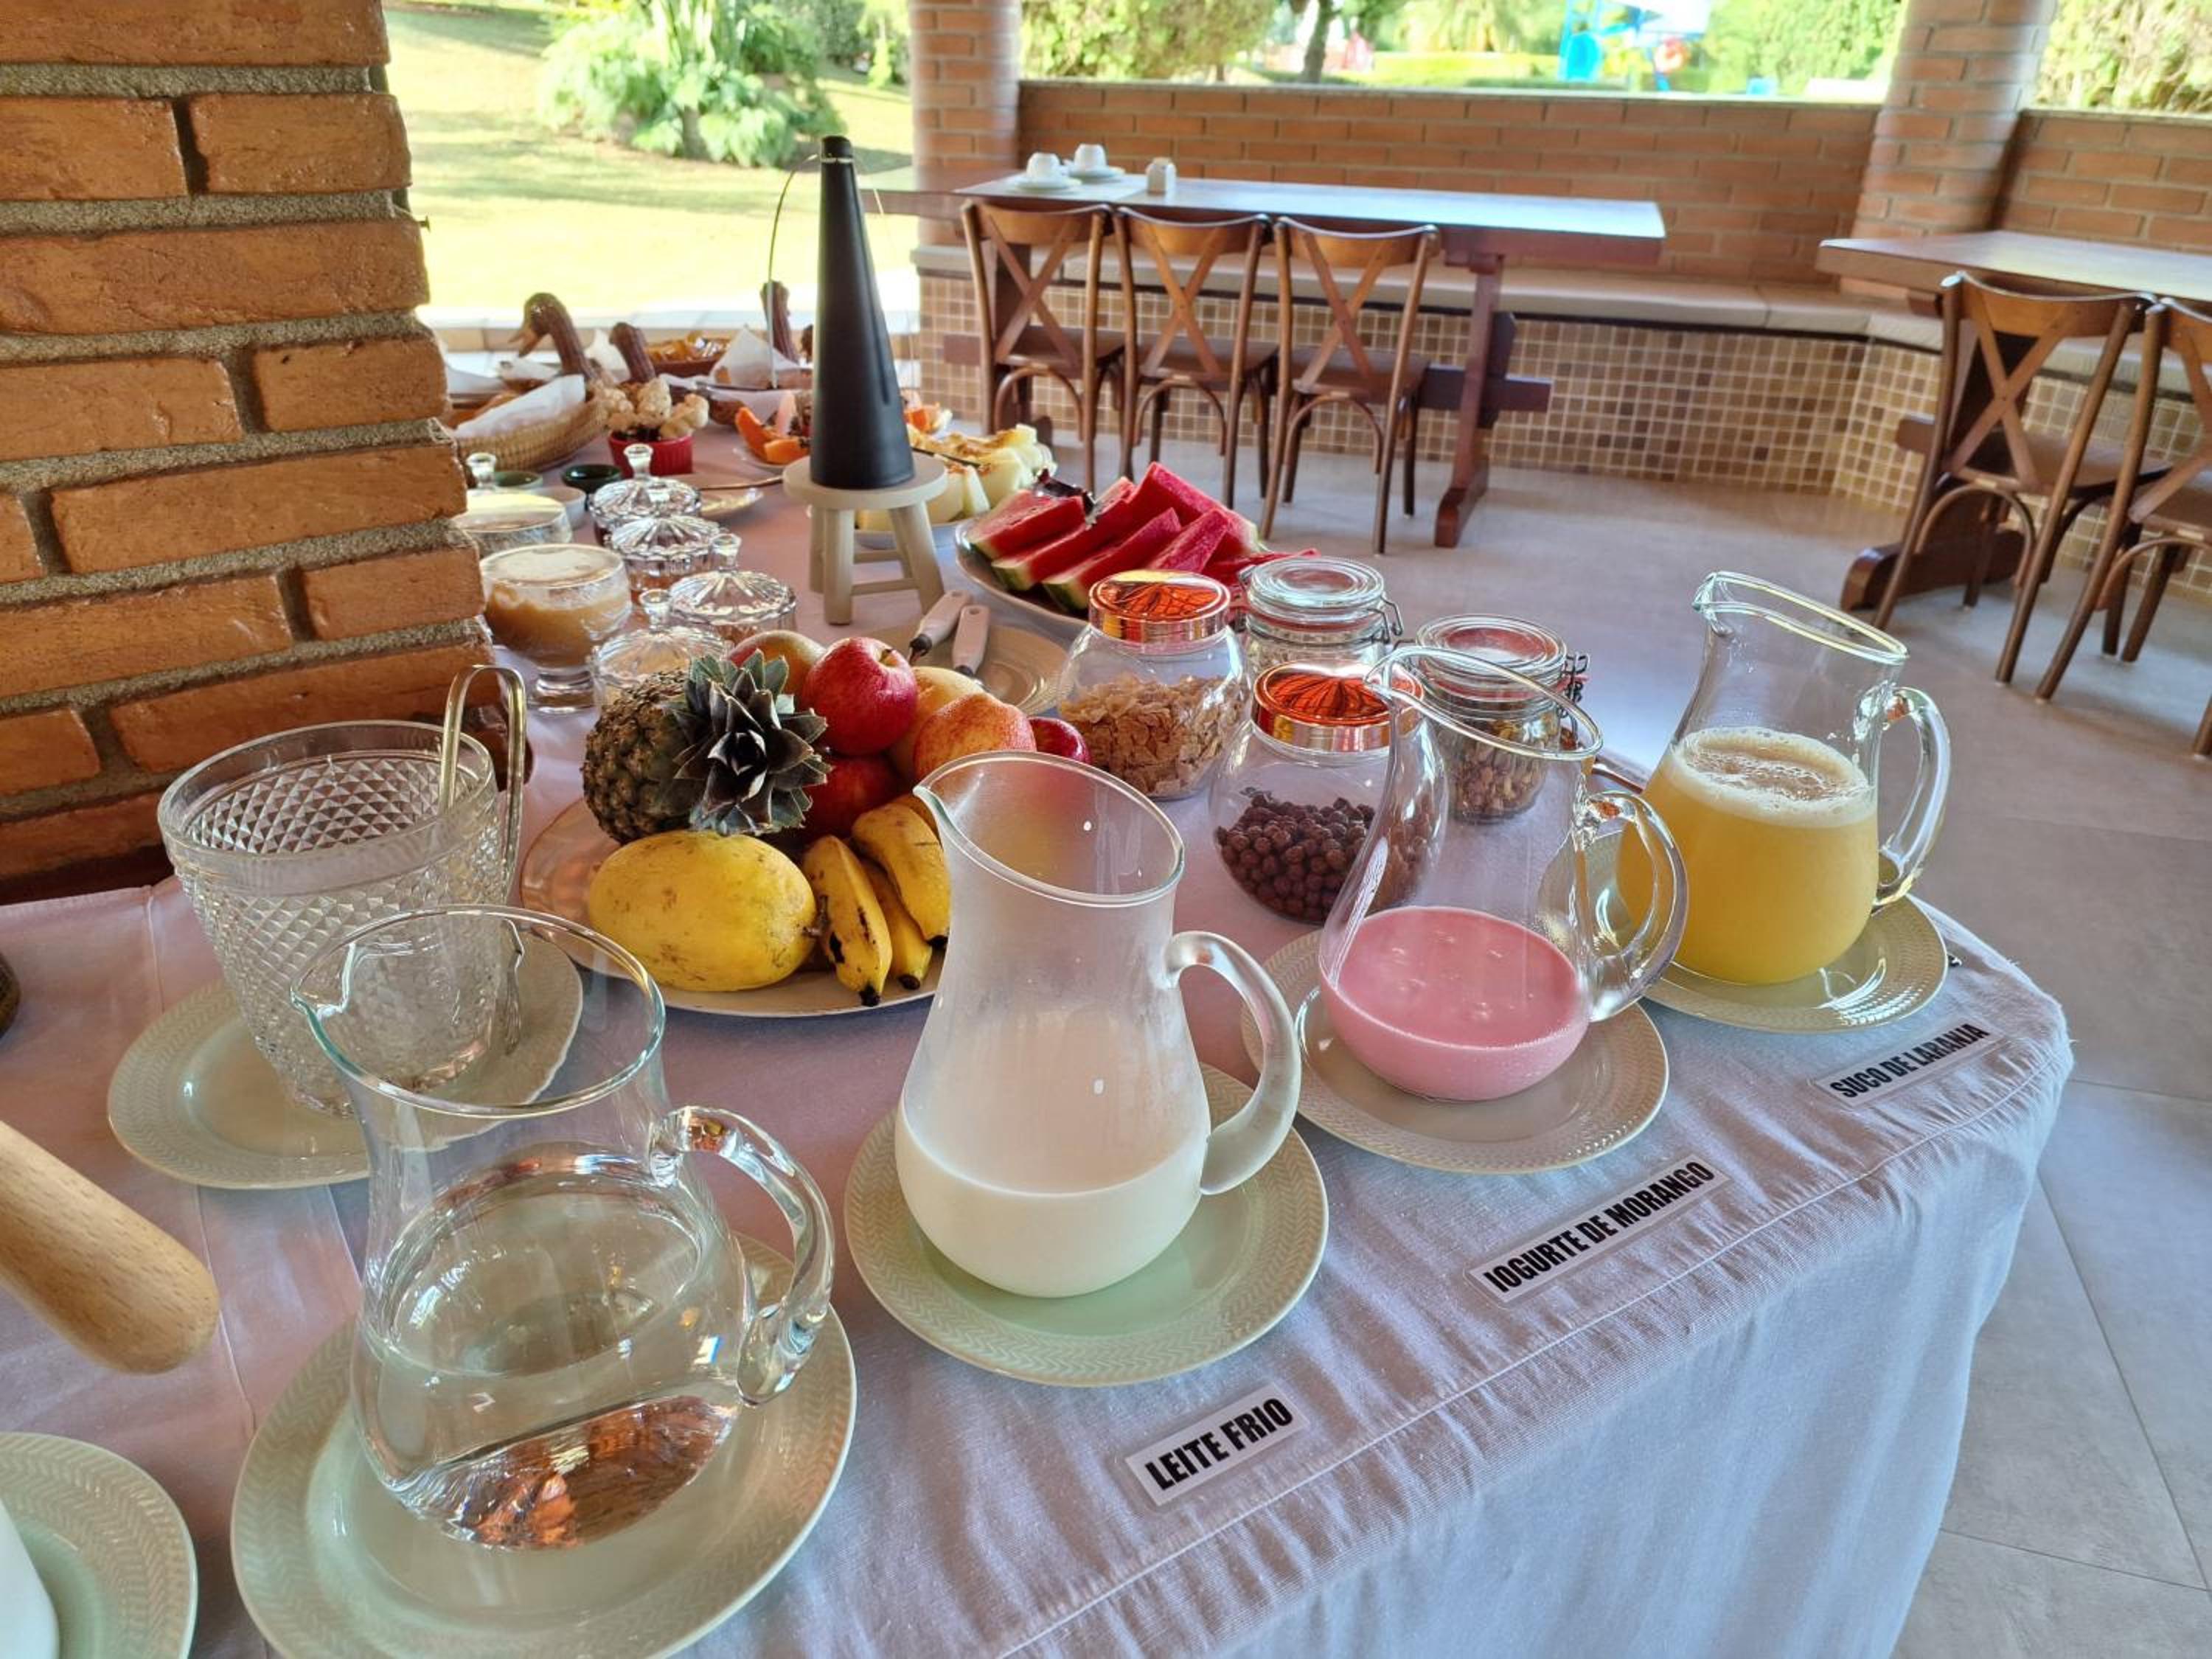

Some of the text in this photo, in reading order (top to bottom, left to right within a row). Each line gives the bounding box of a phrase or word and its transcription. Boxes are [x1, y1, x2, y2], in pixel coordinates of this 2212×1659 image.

[1830, 1023, 1990, 1098] SUCO DE LARANJA
[1484, 1161, 1715, 1293] IOGURTE DE MORANGO
[1145, 1398, 1293, 1491] LEITE FRIO
